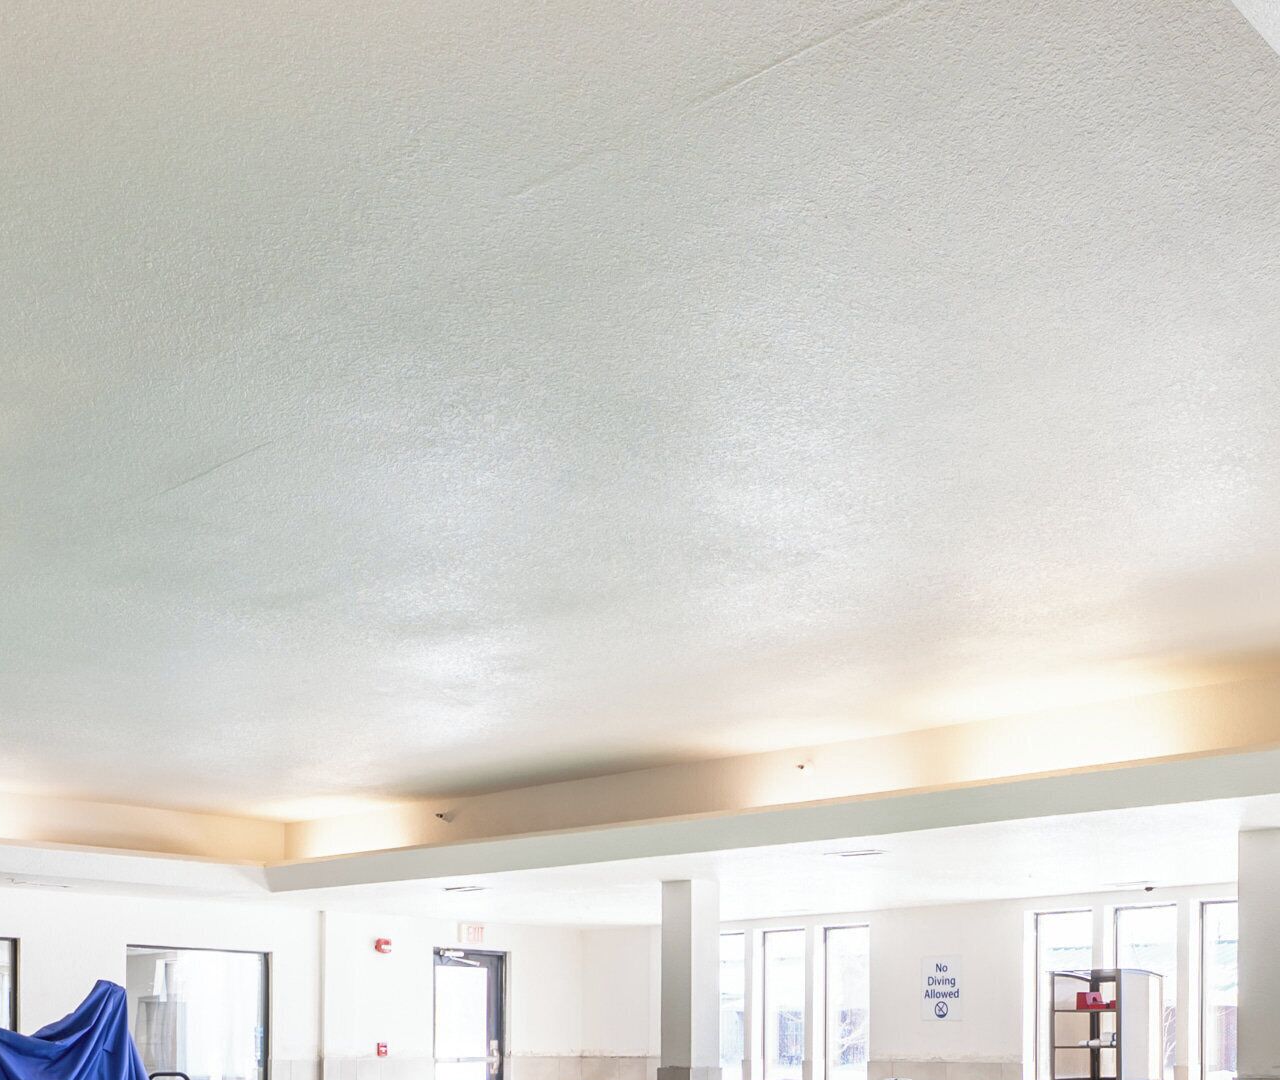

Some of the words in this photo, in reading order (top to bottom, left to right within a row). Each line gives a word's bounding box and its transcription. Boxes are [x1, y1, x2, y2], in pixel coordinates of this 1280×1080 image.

[467, 926, 485, 942] EXIT
[936, 963, 948, 973] No
[927, 976, 956, 988] Diving
[924, 988, 960, 999] Allowed
